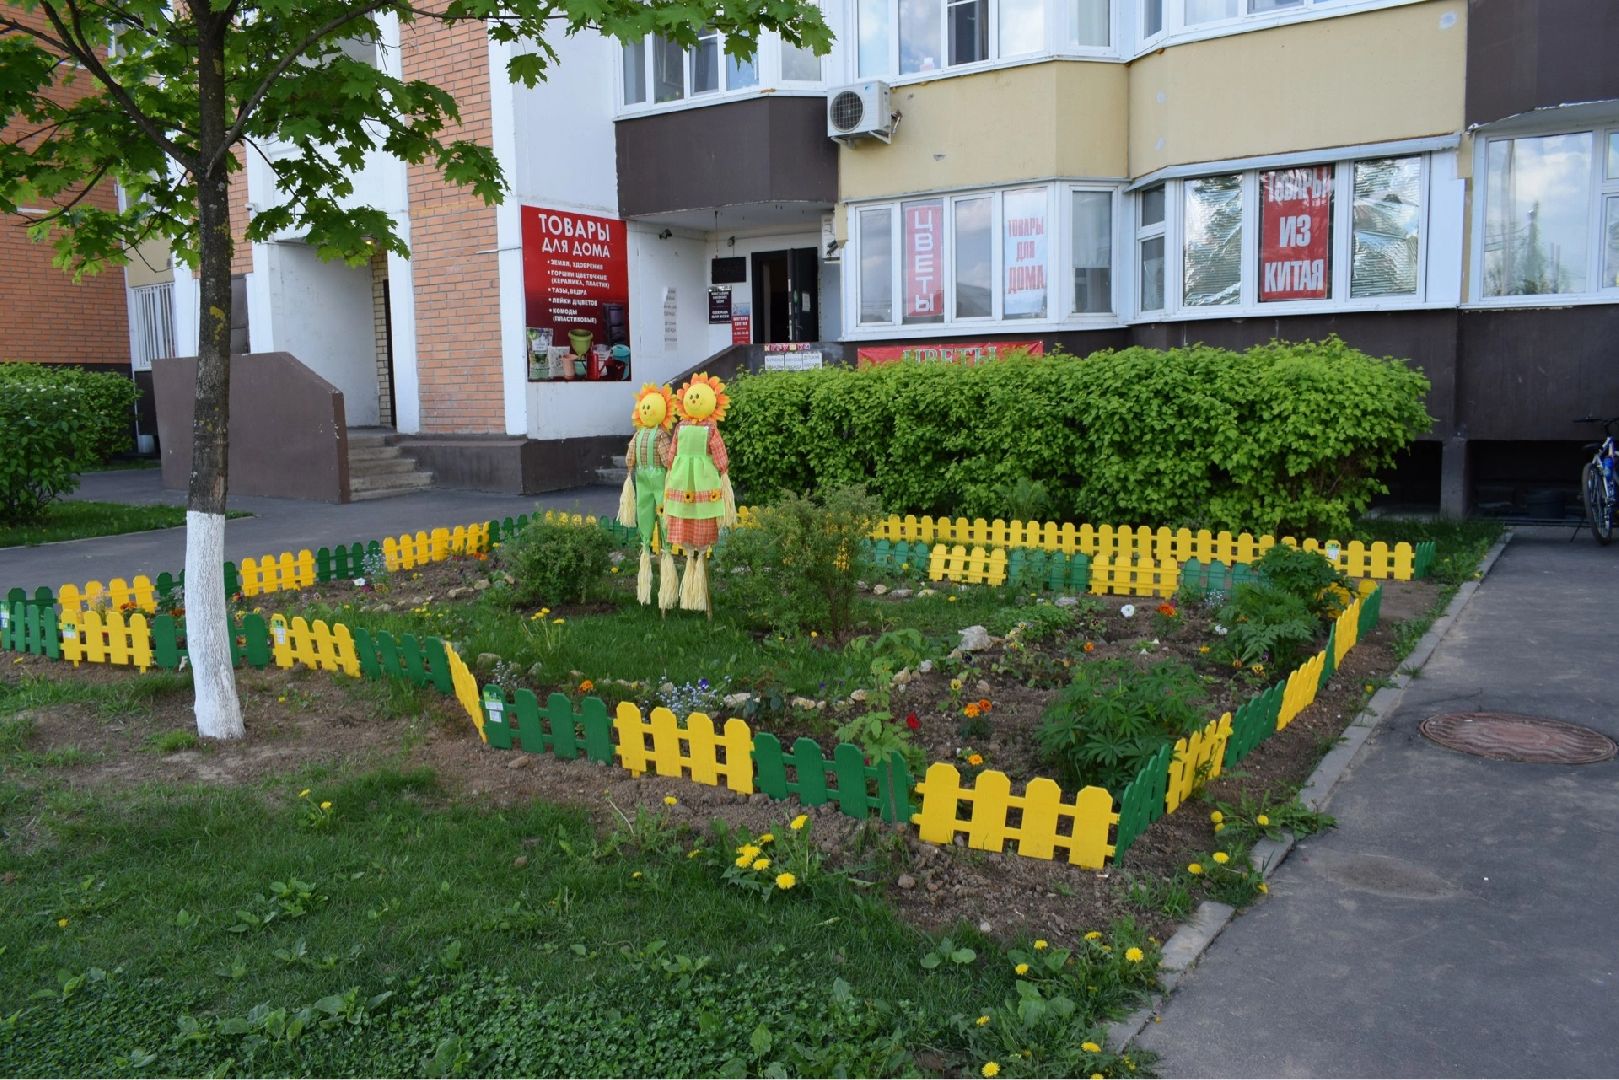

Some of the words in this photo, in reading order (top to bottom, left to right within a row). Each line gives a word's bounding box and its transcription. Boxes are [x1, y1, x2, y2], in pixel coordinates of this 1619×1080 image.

[538, 213, 610, 242] ТОВАРЫ
[1008, 216, 1044, 237] ТОВАРЫ
[1279, 214, 1312, 248] ИЗ
[542, 238, 568, 253] ДЛЯ
[572, 241, 611, 258] ДОМА
[914, 210, 934, 312] ЦВЕТЫ
[1016, 240, 1036, 262] ДЛЯ
[1008, 265, 1044, 294] ДОМА
[1264, 258, 1324, 293] КИТАЯ
